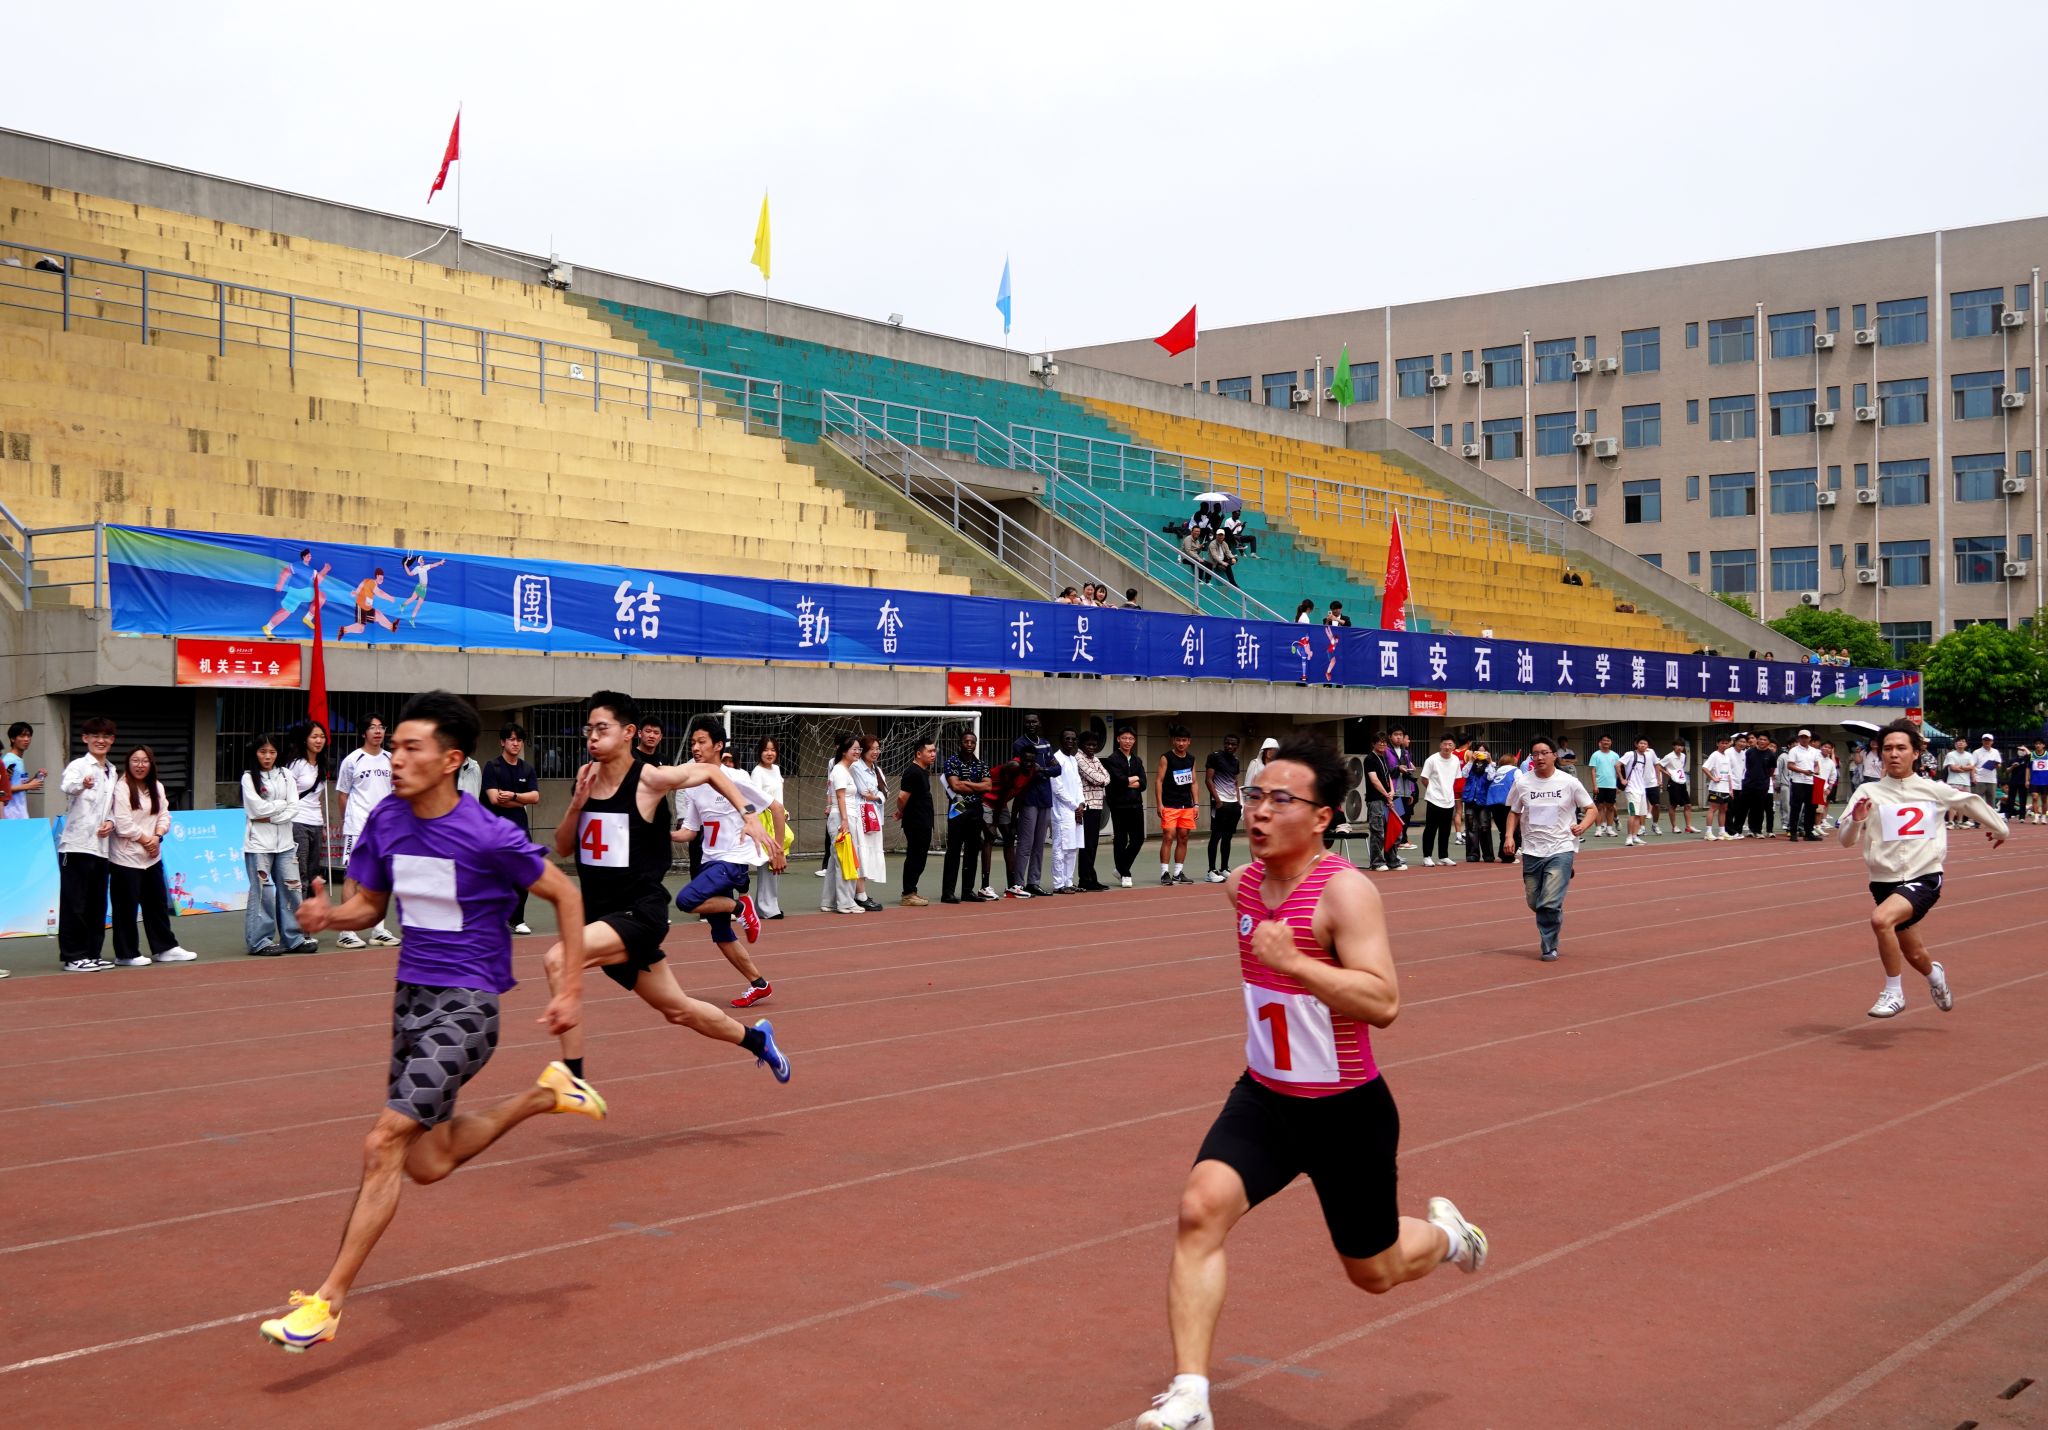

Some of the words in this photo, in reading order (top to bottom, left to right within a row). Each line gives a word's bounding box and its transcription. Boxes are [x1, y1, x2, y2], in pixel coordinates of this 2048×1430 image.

[513, 574, 661, 641] 團結
[797, 595, 903, 653] 勤奮
[1011, 611, 1093, 661] 求是
[1181, 624, 1260, 670] 創新
[200, 658, 279, 675] 机关三工会
[1378, 640, 1890, 700] 西安石油大学第四十五届田径运动会
[964, 686, 995, 697] 理学院
[1176, 774, 1192, 783] 1216
[1677, 769, 1684, 779] 2
[703, 821, 720, 847] 7
[1896, 807, 1924, 836] 2
[581, 819, 608, 860] 4
[1258, 1002, 1292, 1071] 1
